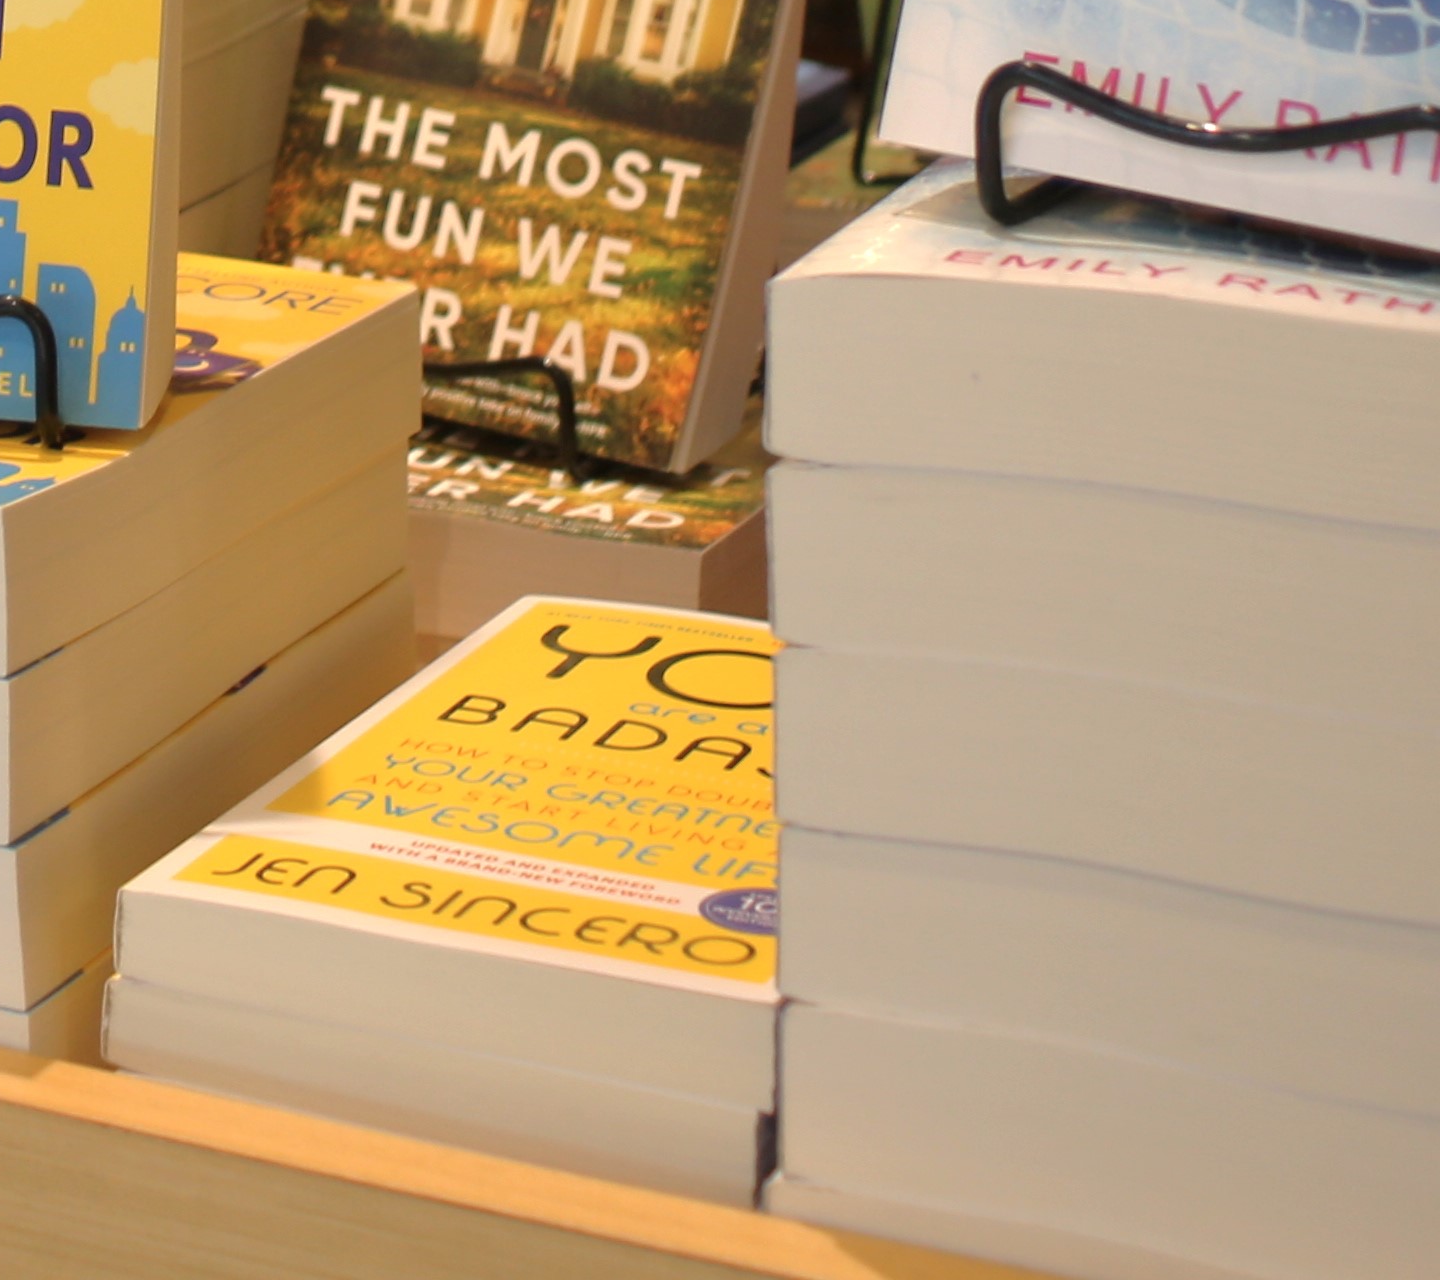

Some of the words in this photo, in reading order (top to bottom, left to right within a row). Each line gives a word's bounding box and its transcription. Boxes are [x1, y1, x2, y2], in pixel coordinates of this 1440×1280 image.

[321, 86, 455, 171] THE
[479, 120, 703, 221] MOST
[339, 180, 485, 266] FUN
[518, 217, 633, 300] WE
[944, 248, 1188, 280] EMILY
[1217, 271, 1436, 315] RATH
[487, 302, 651, 393] HAD
[506, 491, 686, 530] HAD
[435, 693, 775, 782] BADA
[628, 703, 717, 724] are
[385, 752, 528, 793] YOUR
[546, 782, 775, 840] GREATNE
[400, 737, 489, 761] HOW
[504, 752, 550, 771] TO
[565, 765, 656, 792] STOP
[325, 790, 675, 867] AWESOME
[354, 771, 444, 796] AND
[461, 786, 591, 826] START
[606, 816, 748, 851] LIVING
[370, 841, 423, 858] WITH
[444, 855, 566, 888] BRAND-NEW
[569, 879, 682, 908] FOREWORD
[411, 838, 498, 865] UPDATED
[506, 857, 550, 876] AND
[555, 865, 657, 893] EXPANDED
[212, 851, 357, 896] JEN
[380, 882, 757, 966] SINCERO
